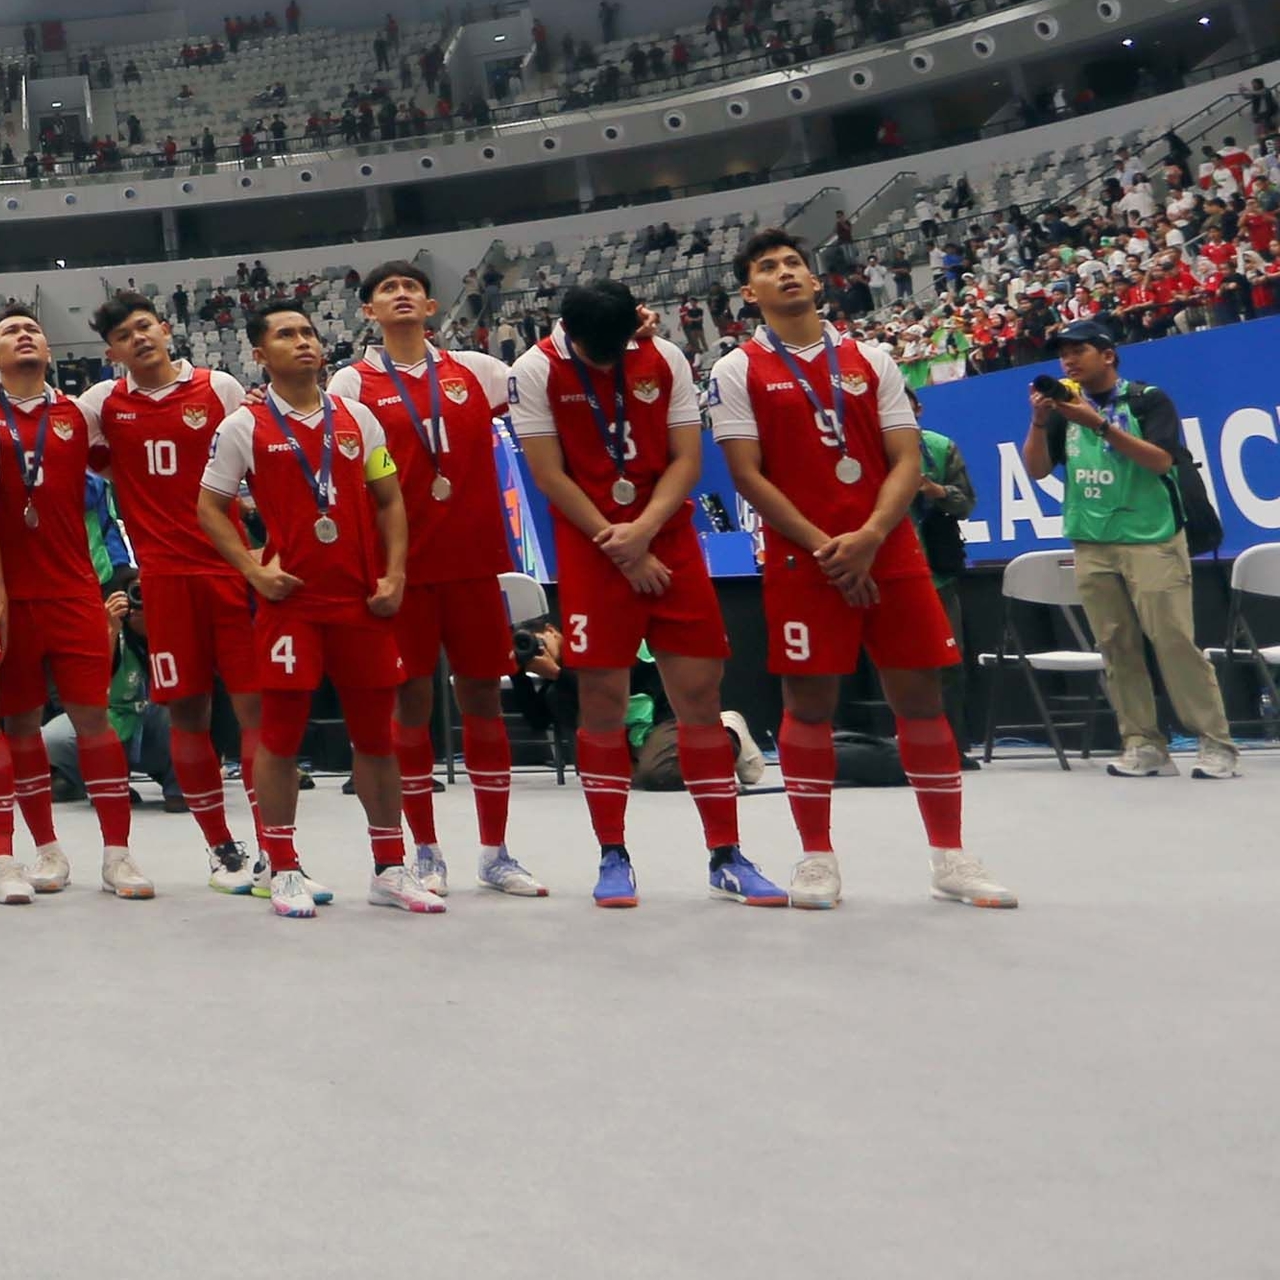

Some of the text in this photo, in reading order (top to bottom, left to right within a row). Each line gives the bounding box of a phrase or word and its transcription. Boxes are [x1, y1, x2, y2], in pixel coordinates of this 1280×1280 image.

[814, 409, 846, 447] 9
[143, 439, 178, 476] 10
[1075, 469, 1114, 485] PHO
[1084, 487, 1102, 499] 02
[569, 614, 588, 653] 3
[783, 621, 810, 661] 9
[150, 651, 179, 689] 10
[271, 635, 296, 674] 4
